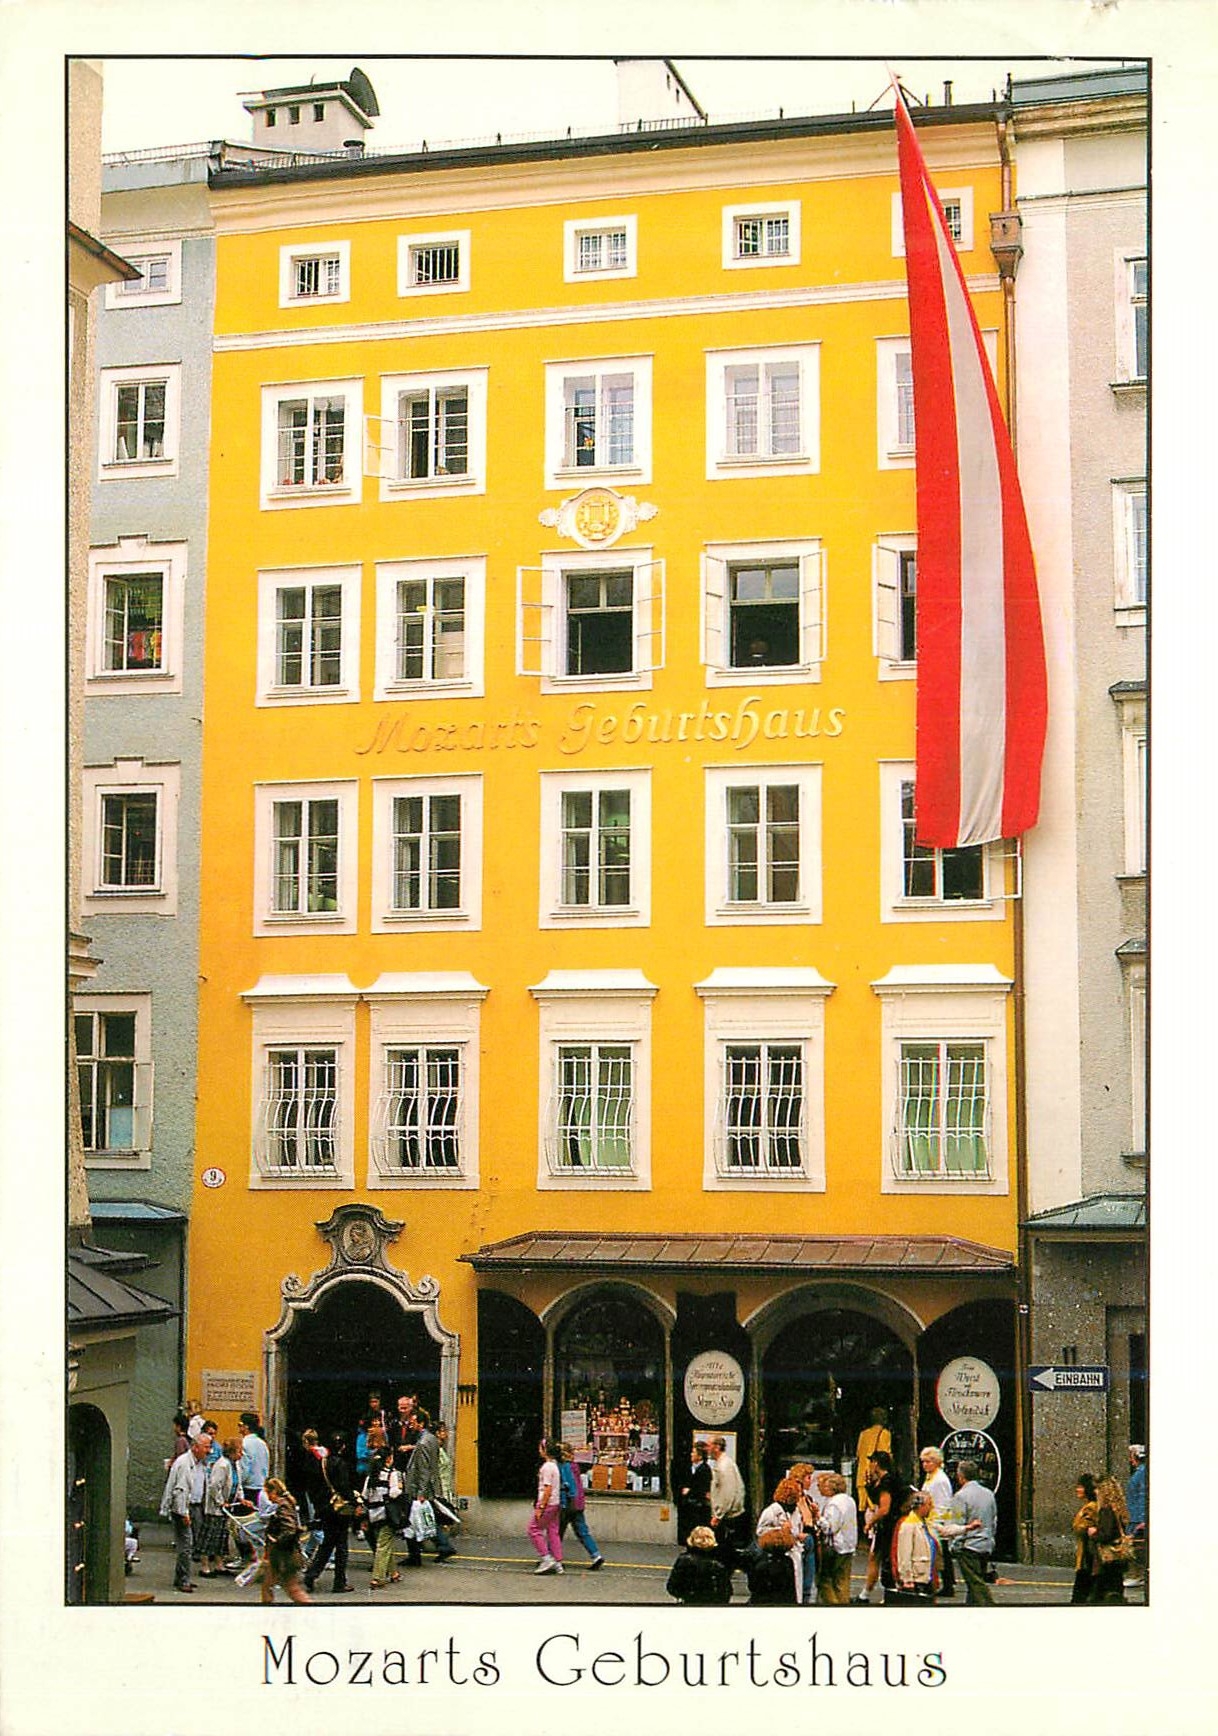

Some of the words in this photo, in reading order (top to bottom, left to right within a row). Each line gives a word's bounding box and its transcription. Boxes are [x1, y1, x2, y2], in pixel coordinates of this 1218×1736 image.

[354, 708, 542, 755] Mozarts
[559, 696, 846, 755] Geburtshaus
[210, 1170, 217, 1181] 9
[1055, 1373, 1100, 1385] EINBAHN
